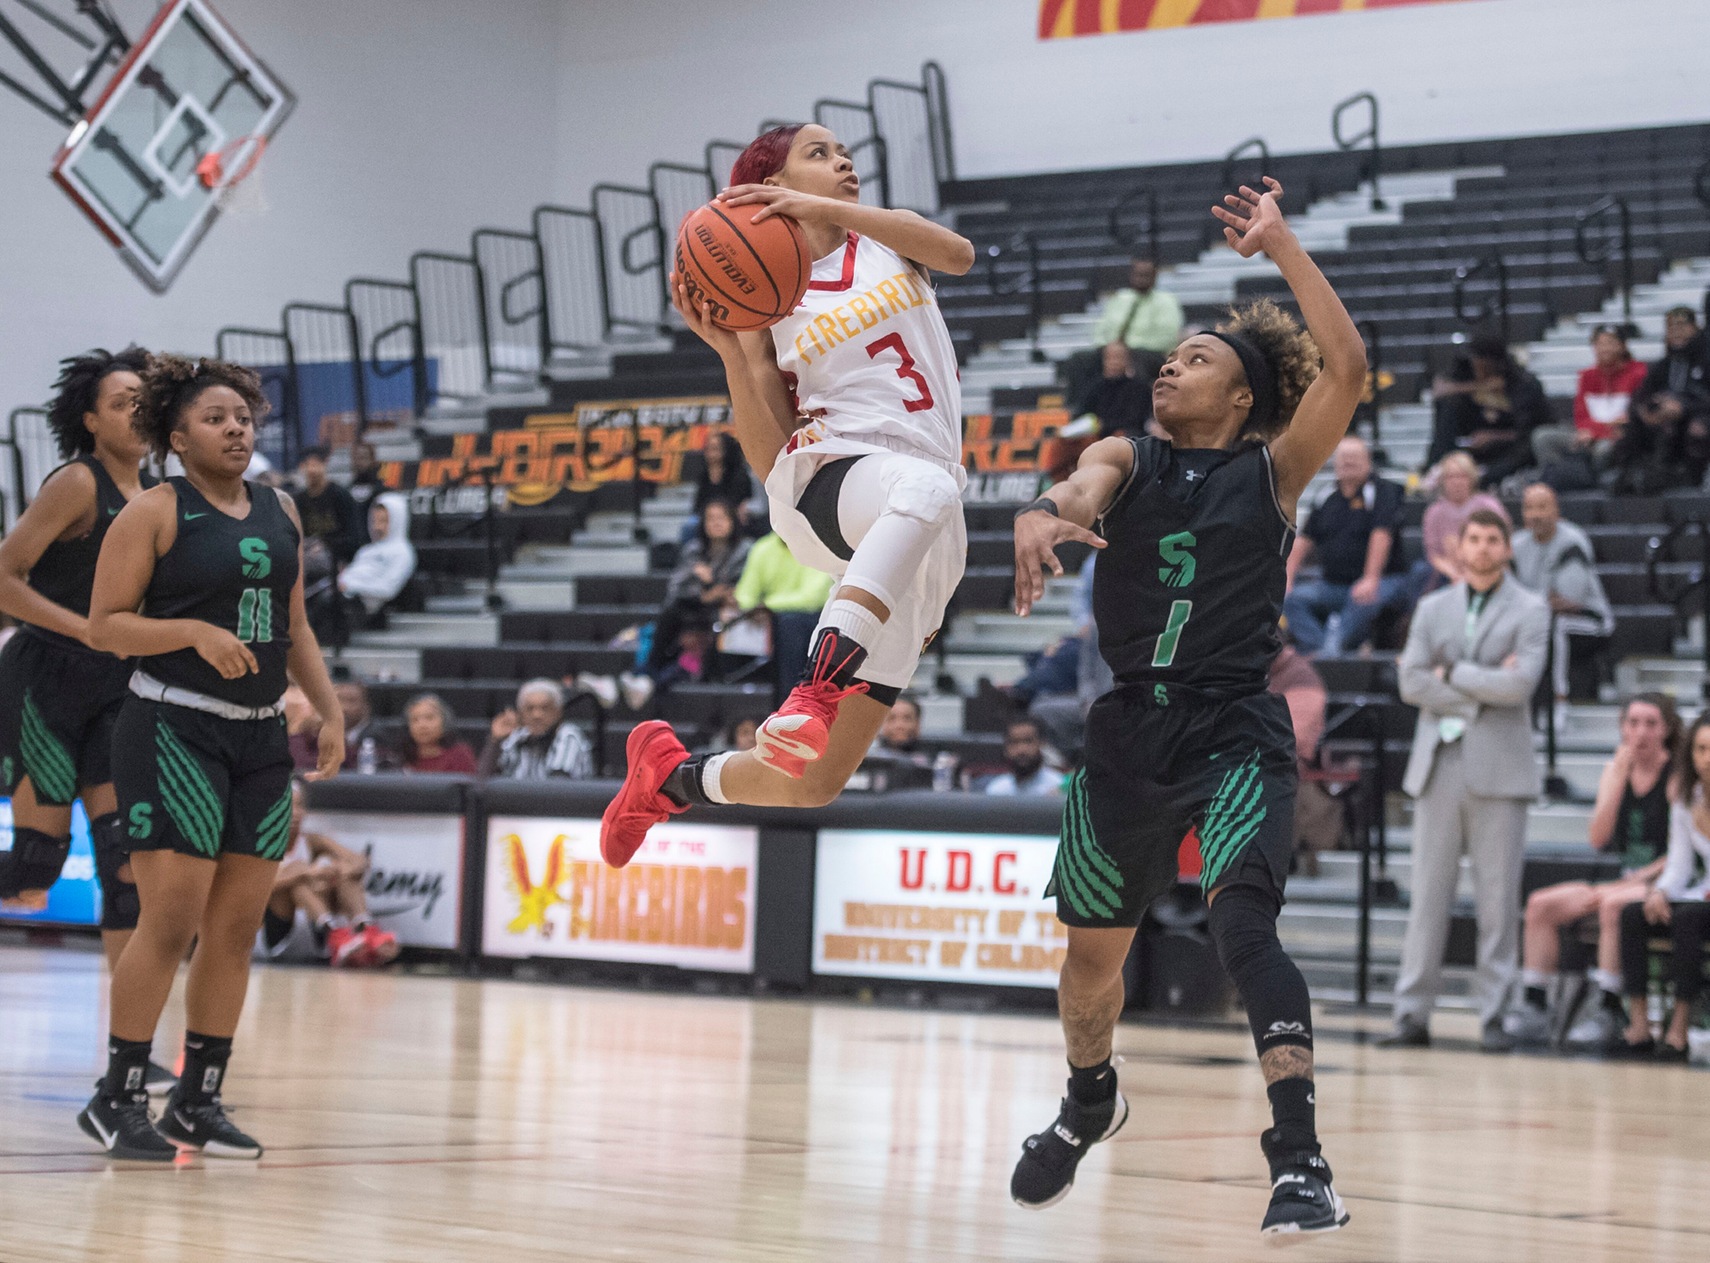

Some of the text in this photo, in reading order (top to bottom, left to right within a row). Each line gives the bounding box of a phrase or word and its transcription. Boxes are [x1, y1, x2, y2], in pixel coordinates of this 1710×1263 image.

[794, 271, 932, 366] FIREBIRD
[865, 331, 935, 413] 3
[238, 537, 272, 579] S
[1158, 531, 1197, 587] S
[237, 588, 273, 643] 11
[1151, 600, 1193, 667] 1
[128, 802, 153, 839] S
[899, 847, 1031, 897] U.D.C.
